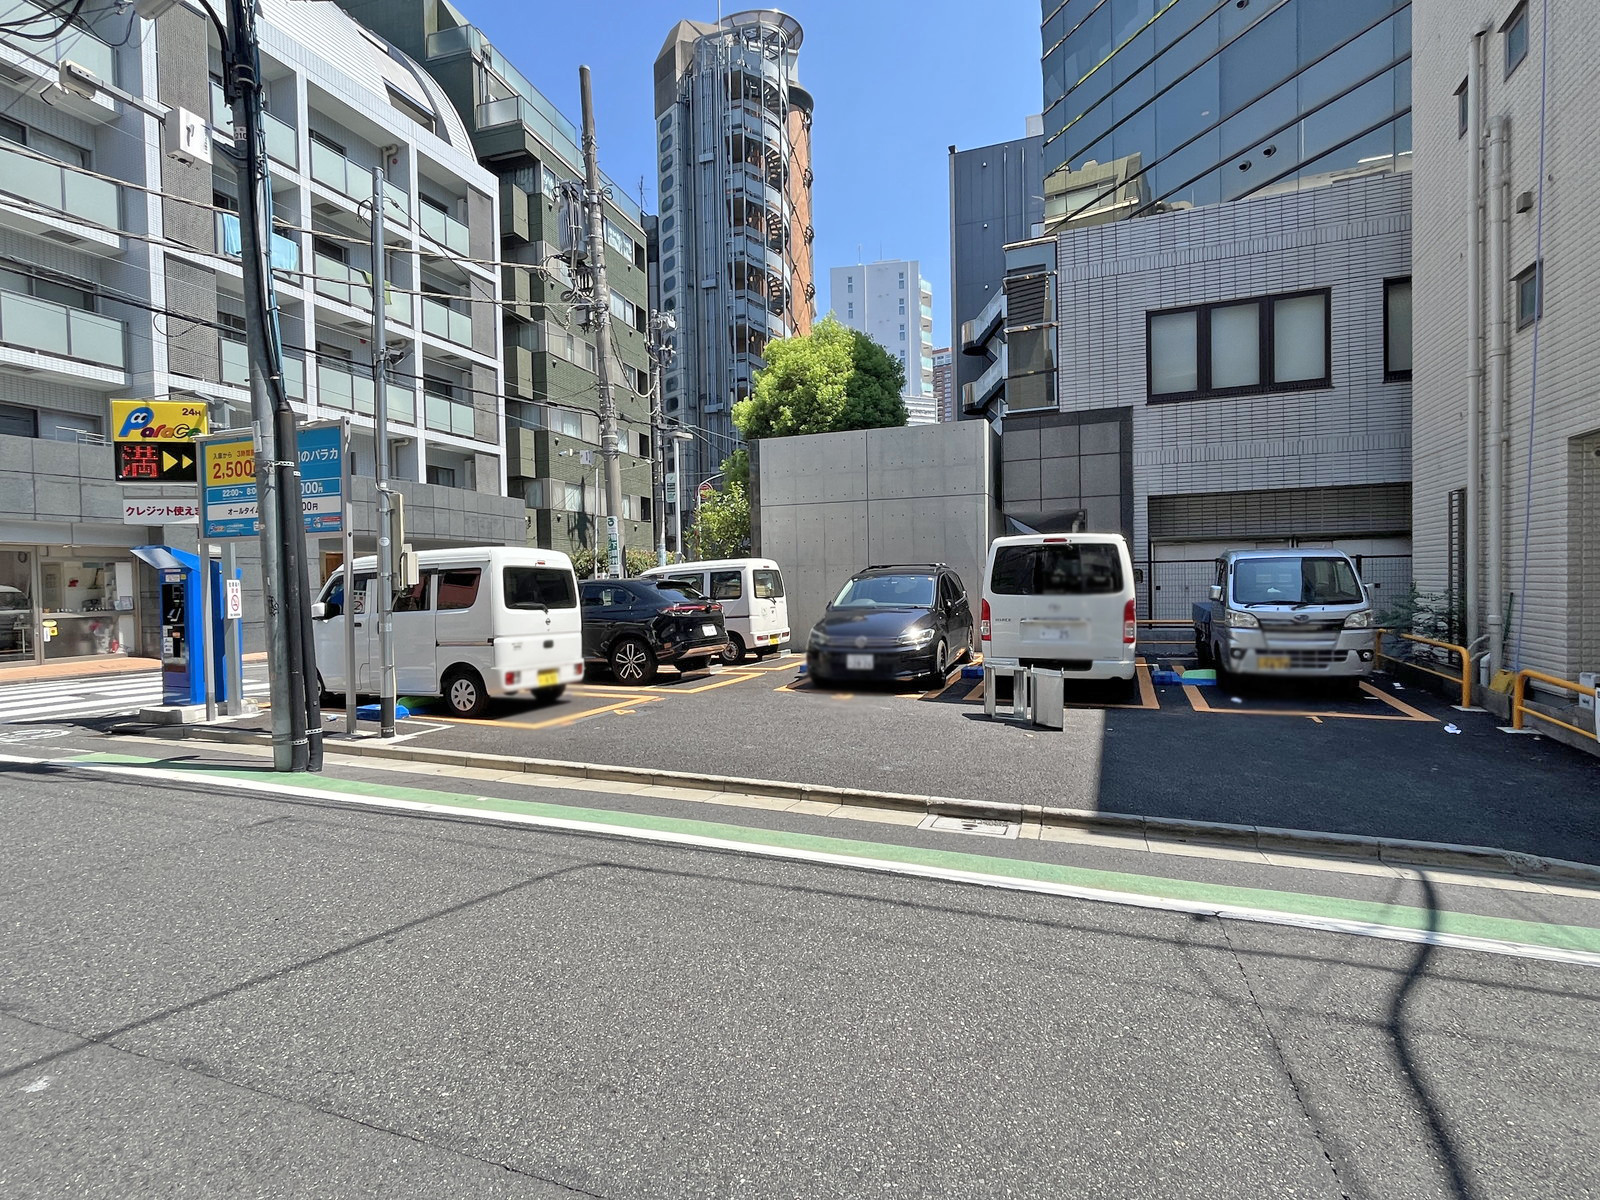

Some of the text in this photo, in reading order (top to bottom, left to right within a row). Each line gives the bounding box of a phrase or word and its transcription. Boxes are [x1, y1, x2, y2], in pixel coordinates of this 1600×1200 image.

[182, 407, 201, 416] 24H
[122, 445, 158, 477] 満
[297, 447, 338, 463] のパラカ
[213, 459, 256, 480] 2,500
